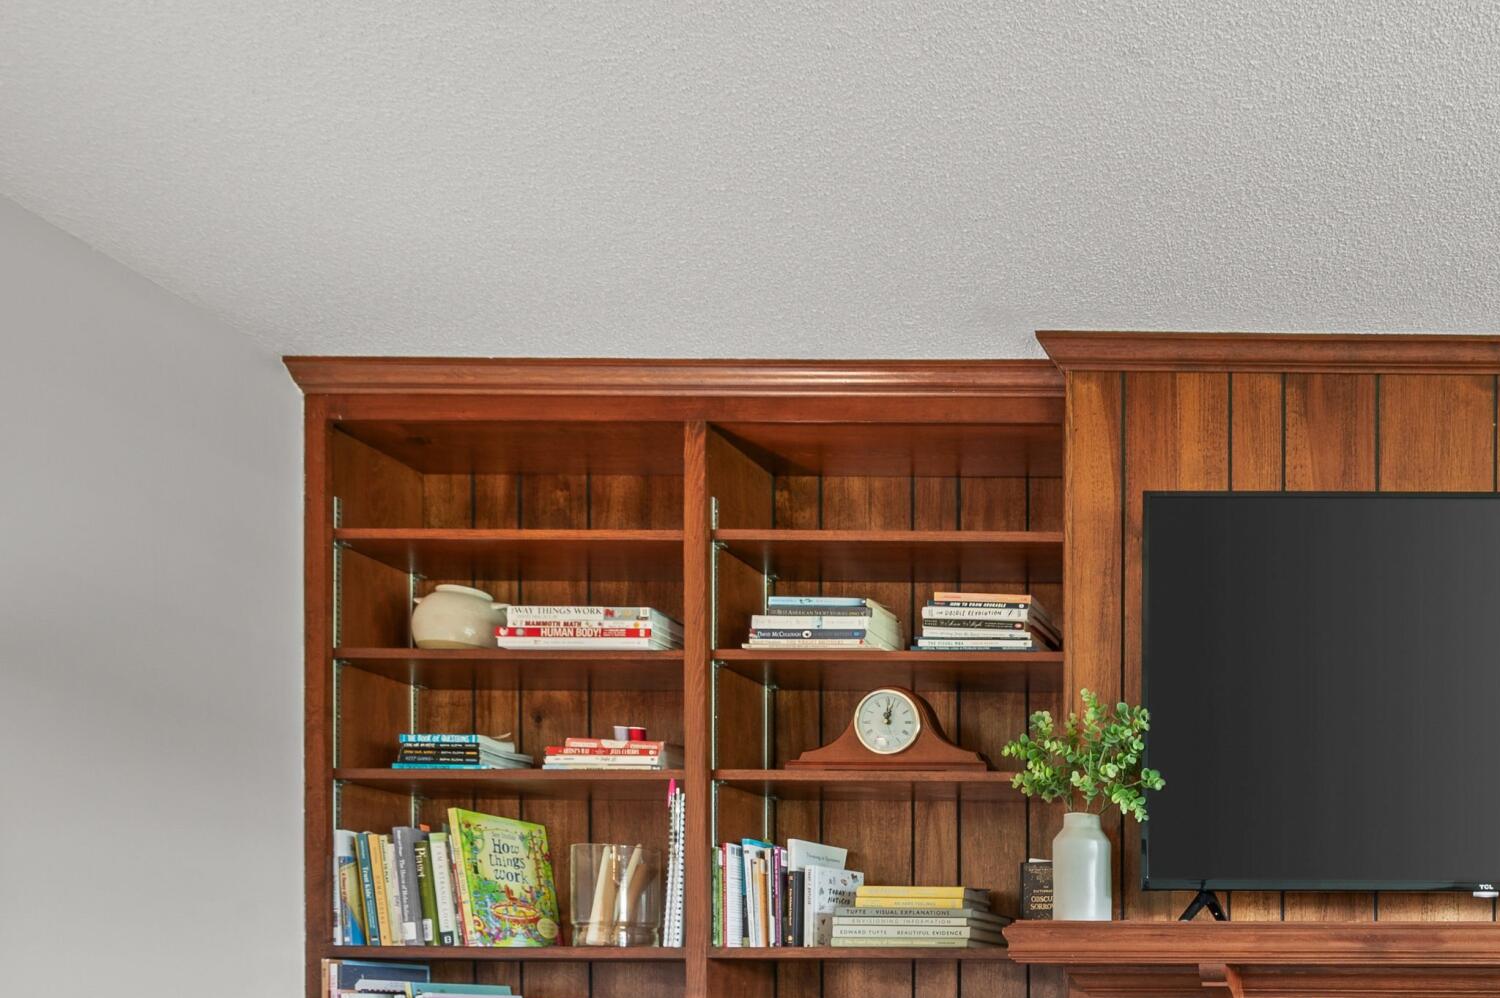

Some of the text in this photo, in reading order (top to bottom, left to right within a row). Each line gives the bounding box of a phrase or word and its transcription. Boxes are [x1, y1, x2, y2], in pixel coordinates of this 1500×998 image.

[541, 628, 574, 637] HUMAN
[576, 628, 601, 637] BODY!
[491, 838, 519, 854] How
[489, 854, 525, 869] things
[362, 866, 370, 883] Trust
[494, 868, 529, 884] work
